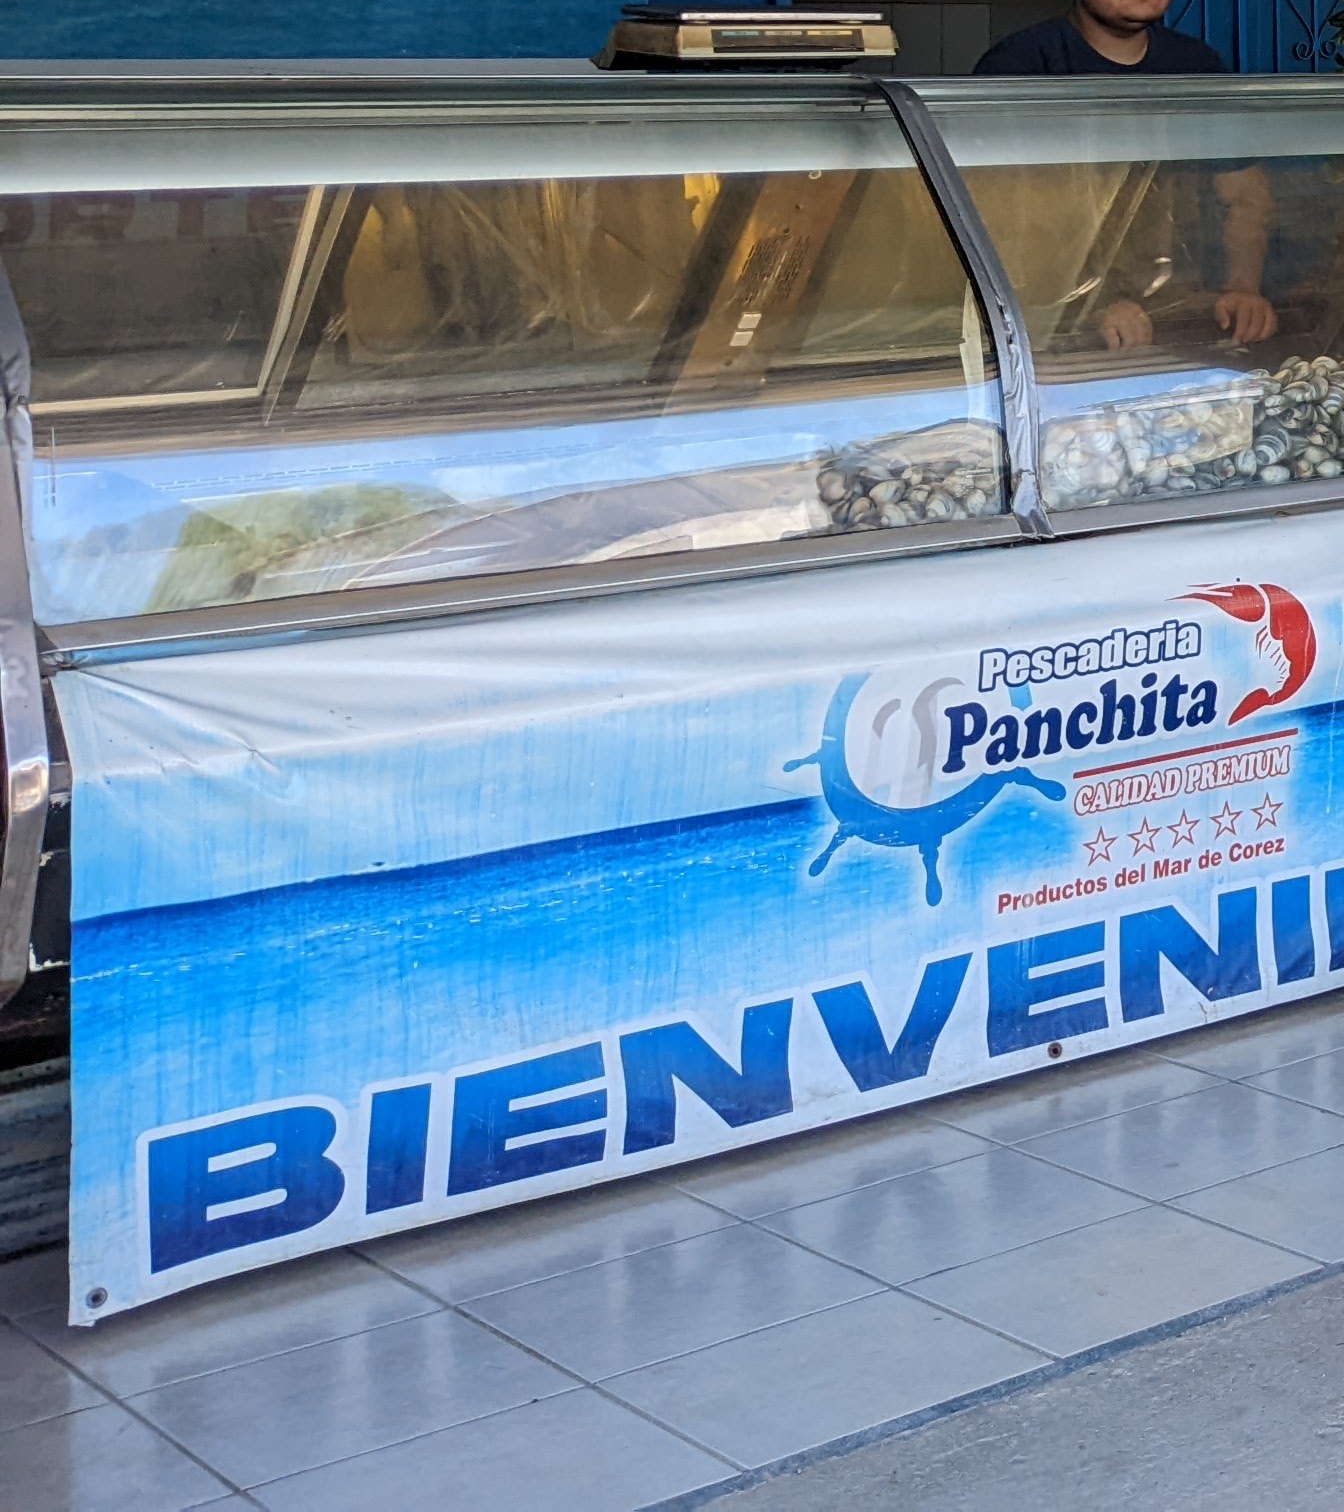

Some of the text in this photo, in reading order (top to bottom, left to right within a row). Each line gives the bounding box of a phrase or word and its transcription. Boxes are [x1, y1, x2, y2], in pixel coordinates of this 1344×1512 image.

[978, 619, 1202, 693] Pescaderia
[942, 672, 1218, 774] Panchita
[1073, 744, 1292, 816] CALIDAD PREMIUM
[997, 837, 1286, 914] Productos del Mar de Corez
